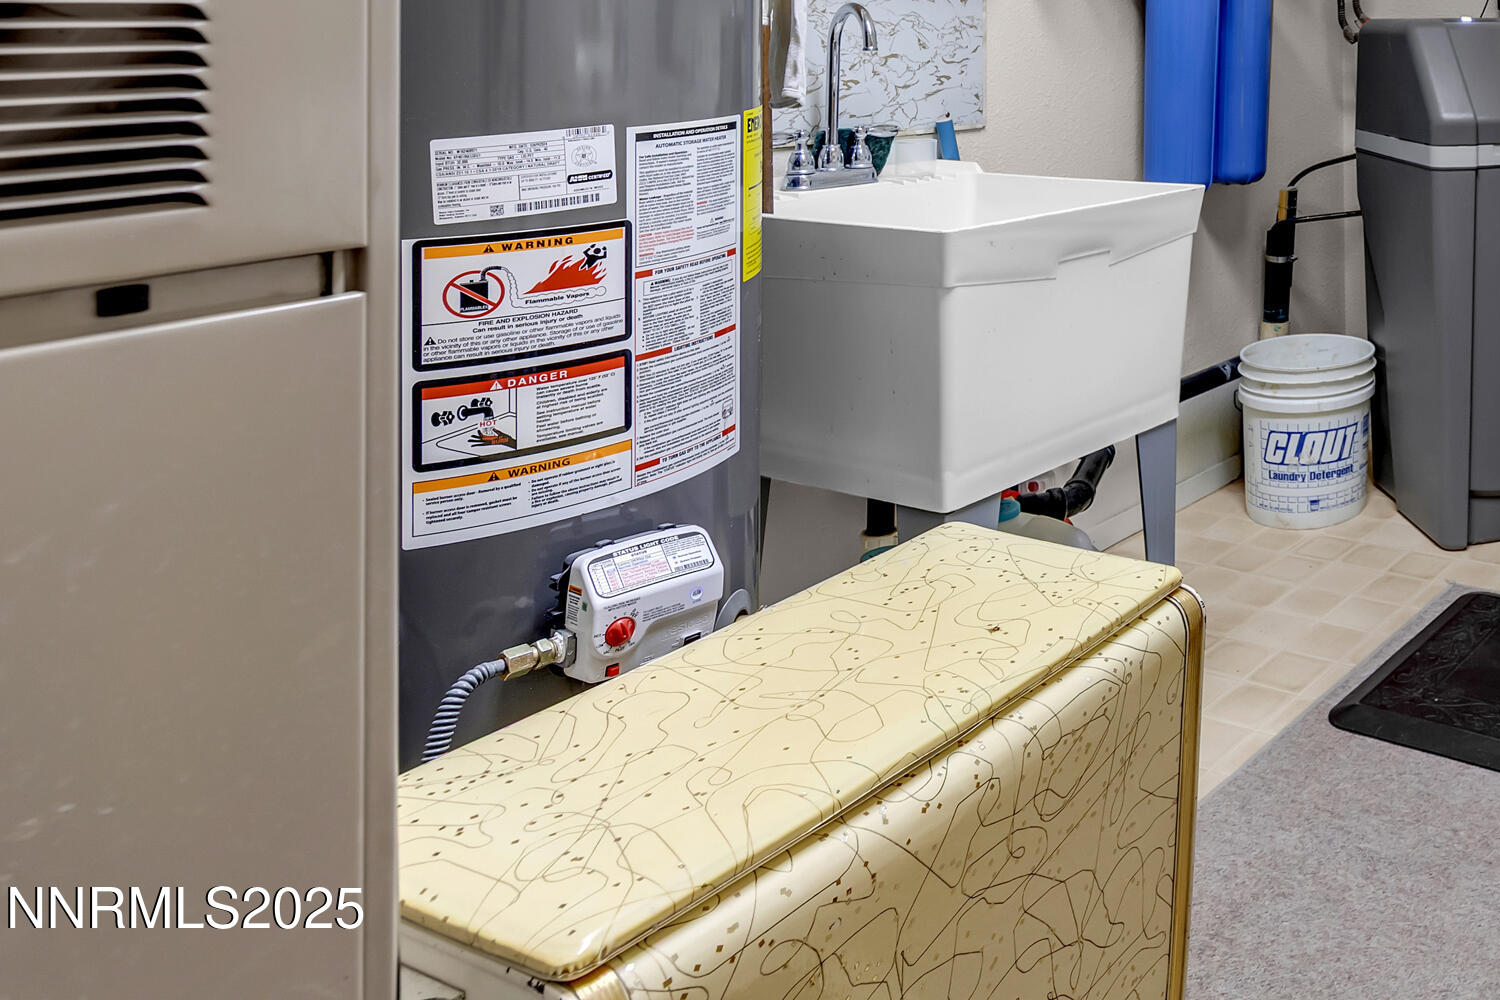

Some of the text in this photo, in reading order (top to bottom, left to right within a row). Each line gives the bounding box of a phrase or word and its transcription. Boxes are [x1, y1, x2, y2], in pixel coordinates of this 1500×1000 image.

[653, 130, 682, 138] INSTALLATION
[502, 236, 574, 252] WARNING
[525, 291, 590, 304] Flammable Vapors
[512, 314, 550, 323] EXPLOSION
[552, 309, 578, 317] HAZARD
[546, 321, 574, 329] flammable
[674, 336, 714, 352] LIGHTING INSTRUCTIONS
[507, 370, 568, 388] DANGER
[480, 420, 497, 428] HOT
[1264, 422, 1358, 466] CLOUT
[508, 458, 570, 478] WARNING
[1268, 464, 1353, 483] Laundry Detergent
[612, 546, 639, 557] STATUS
[640, 540, 660, 550] LIGHT
